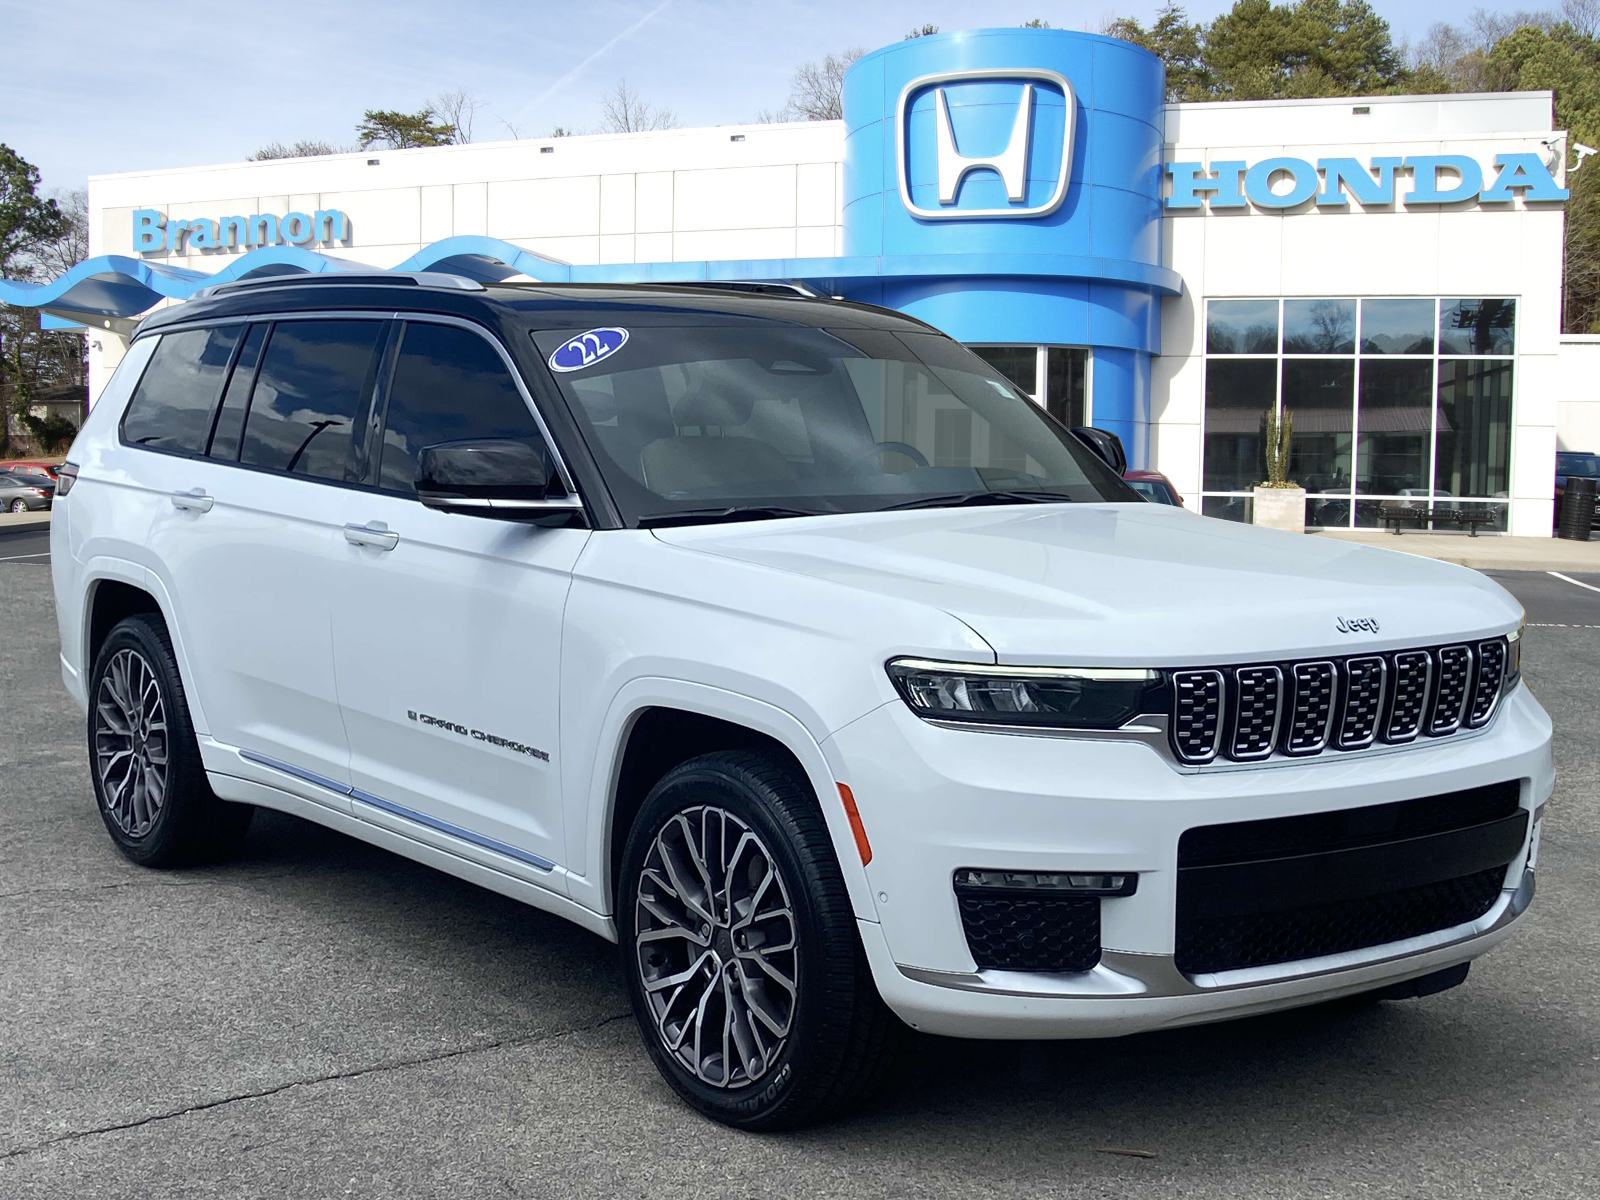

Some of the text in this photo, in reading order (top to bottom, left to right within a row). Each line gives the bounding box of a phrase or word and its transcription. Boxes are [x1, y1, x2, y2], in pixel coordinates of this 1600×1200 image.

[1164, 152, 1570, 209] HONDA
[132, 208, 348, 253] Brannon
[568, 333, 611, 365] 22
[1335, 615, 1380, 634] Jeep
[419, 713, 468, 736] GRAND
[470, 729, 550, 763] CHEROKEE
